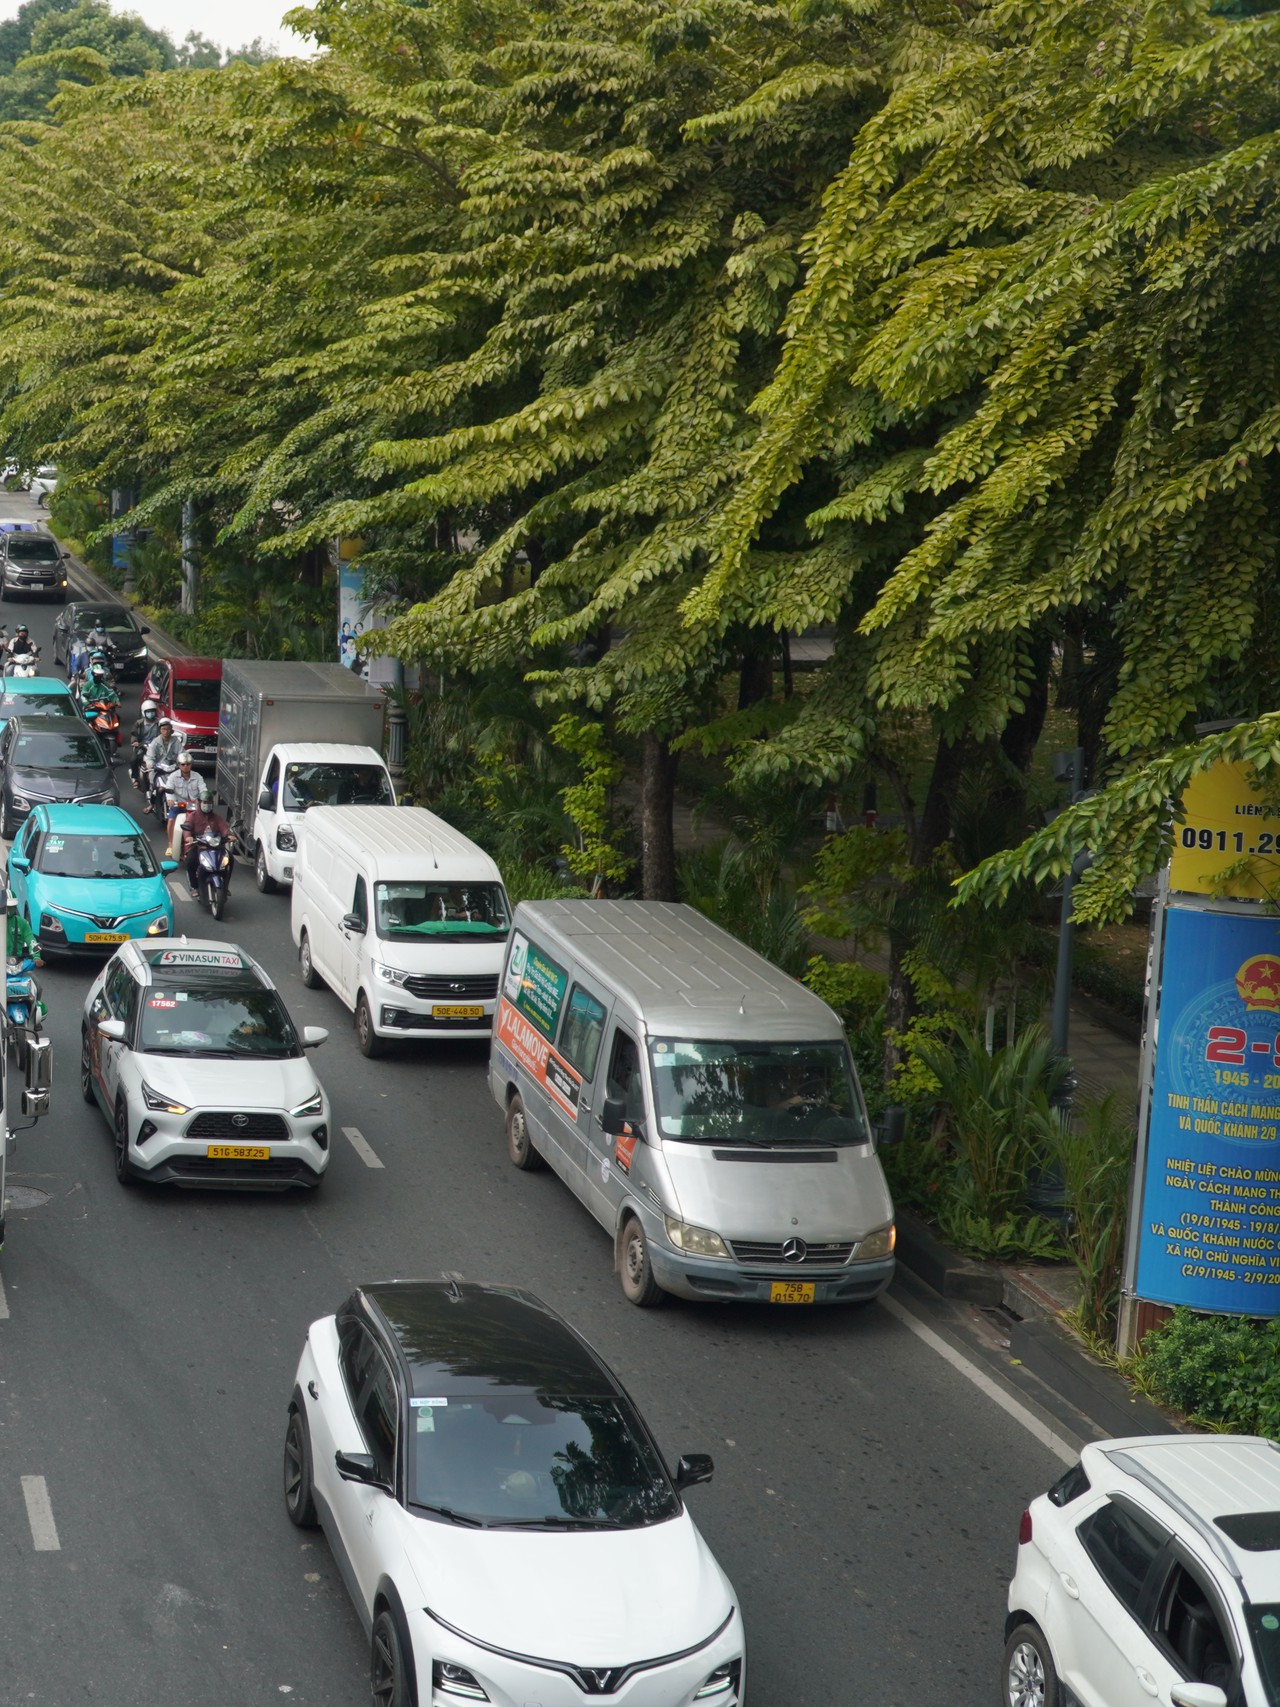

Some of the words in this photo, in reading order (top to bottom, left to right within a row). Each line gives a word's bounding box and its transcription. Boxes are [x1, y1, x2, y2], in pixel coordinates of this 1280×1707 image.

[179, 954, 220, 964] VINASUN
[221, 956, 240, 966] TAXI
[436, 1008, 480, 1016] 50E-448.50
[506, 1011, 550, 1068] LALAMOVE
[1206, 1026, 1280, 1068] 2-
[1214, 1069, 1250, 1086] 1945
[1168, 1094, 1190, 1110] TINH
[1192, 1095, 1219, 1114] THẦN
[1221, 1100, 1248, 1118] CÁCH
[1251, 1104, 1280, 1122] MẠNG
[1179, 1114, 1192, 1130] VÀ
[1194, 1116, 1221, 1134] QUỐC
[1223, 1122, 1258, 1139] KHÁNH
[1261, 1127, 1277, 1140] 2/9
[1166, 1158, 1196, 1174] NHIỆT
[1198, 1162, 1216, 1178] LIỆT
[1220, 1166, 1252, 1180] CHÀO
[1166, 1175, 1196, 1190] NGÀY
[1198, 1179, 1230, 1195] CÁCH
[1233, 1186, 1267, 1200] MẠNG
[1210, 1199, 1246, 1214] THÀNH
[1249, 1202, 1280, 1216] CÔNG
[1180, 1212, 1240, 1230] (19/8/1945
[1151, 1222, 1164, 1236] VÀ
[1168, 1226, 1200, 1242] QUỐC
[1202, 1232, 1240, 1247] KHÁNH
[1242, 1236, 1275, 1249] NƯỚC
[1166, 1244, 1181, 1256] XÃ
[1184, 1247, 1202, 1262] HỘI
[1206, 1250, 1229, 1262] CHỦ
[1232, 1254, 1266, 1266] NGHĨA
[1182, 1264, 1236, 1280] (2/9/1945
[784, 1284, 803, 1292] 75B
